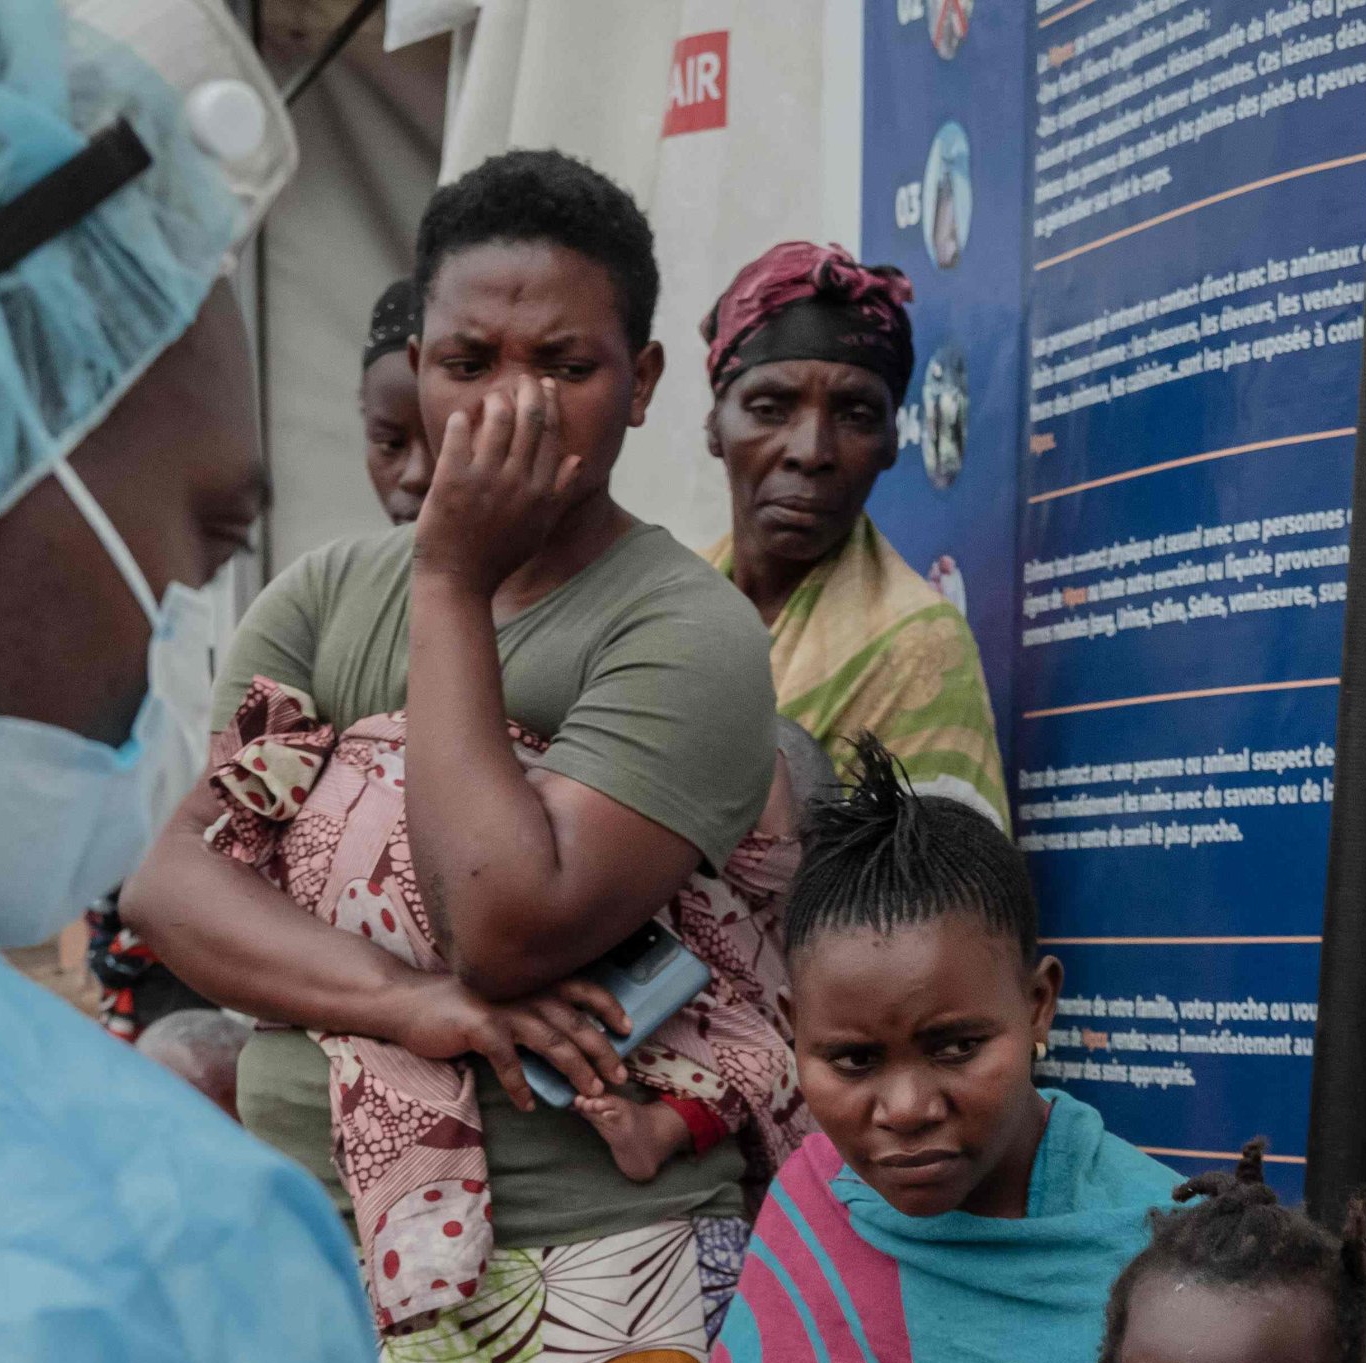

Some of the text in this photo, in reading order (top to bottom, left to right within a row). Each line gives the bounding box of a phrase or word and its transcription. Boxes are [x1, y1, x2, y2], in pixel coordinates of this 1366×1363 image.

[1145, 64, 1166, 89] avec
[1247, 18, 1264, 43] de
[1265, 1, 1310, 37] liquide
[670, 52, 721, 108] AIR
[1190, 79, 1209, 103] des
[1211, 61, 1256, 94] croutes.
[1258, 51, 1281, 75] Ces
[1282, 34, 1334, 66] lésions
[1179, 121, 1195, 143] les
[1195, 104, 1235, 141] plantes
[1236, 95, 1259, 119] des
[1260, 79, 1296, 116] pieds
[1297, 74, 1315, 98] et
[895, 181, 922, 230] 03
[1159, 283, 1199, 314] contact
[1200, 273, 1235, 301] direct
[1236, 267, 1266, 291] avec
[1268, 260, 1288, 283] les
[1290, 246, 1360, 278] animaux
[1201, 314, 1219, 337] les
[1220, 301, 1276, 331] éleveurs,
[1278, 293, 1301, 316] les
[1204, 348, 1222, 371] les
[1223, 341, 1251, 371] plus
[1252, 325, 1312, 361] exposée
[1203, 525, 1233, 547] avec
[1234, 521, 1260, 542] une
[1262, 509, 1345, 543] personnes
[1225, 550, 1273, 581] liquide
[1275, 545, 1350, 577] provenan
[1228, 584, 1317, 612] vomissures,
[1319, 582, 1347, 603] sue
[1185, 757, 1202, 775] ou
[1203, 748, 1249, 774] animal
[1251, 746, 1312, 774] suspect
[1314, 742, 1336, 766] de
[1174, 791, 1203, 810] avec
[1224, 786, 1276, 807] savons
[1277, 785, 1298, 804] ou
[1300, 778, 1321, 803] de
[1191, 818, 1244, 848] proche.
[1216, 997, 1268, 1025] proche
[1270, 1003, 1290, 1021] ou
[1180, 1029, 1292, 1055] immédiatement
[1293, 1037, 1313, 1056] au
